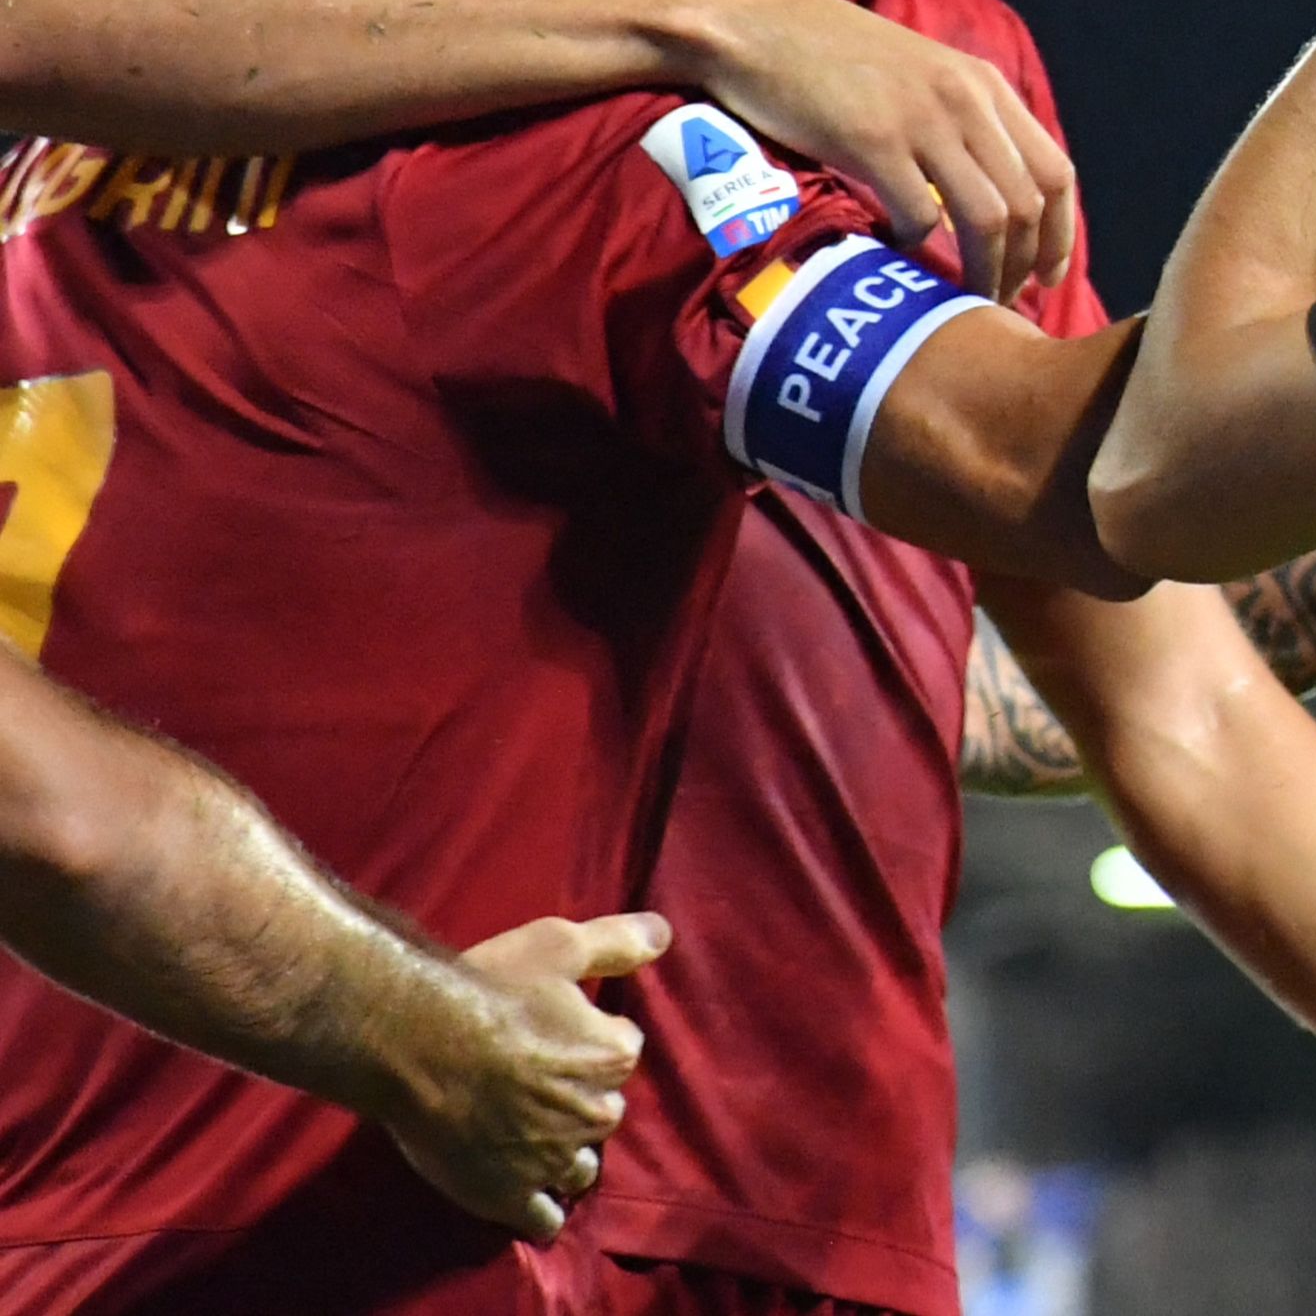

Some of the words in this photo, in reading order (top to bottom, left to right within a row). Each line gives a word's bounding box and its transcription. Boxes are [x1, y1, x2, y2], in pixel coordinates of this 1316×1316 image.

[702, 174, 756, 209] SERIE
[761, 169, 773, 181] A
[746, 203, 790, 235] TIM
[776, 260, 939, 423] PEACE
